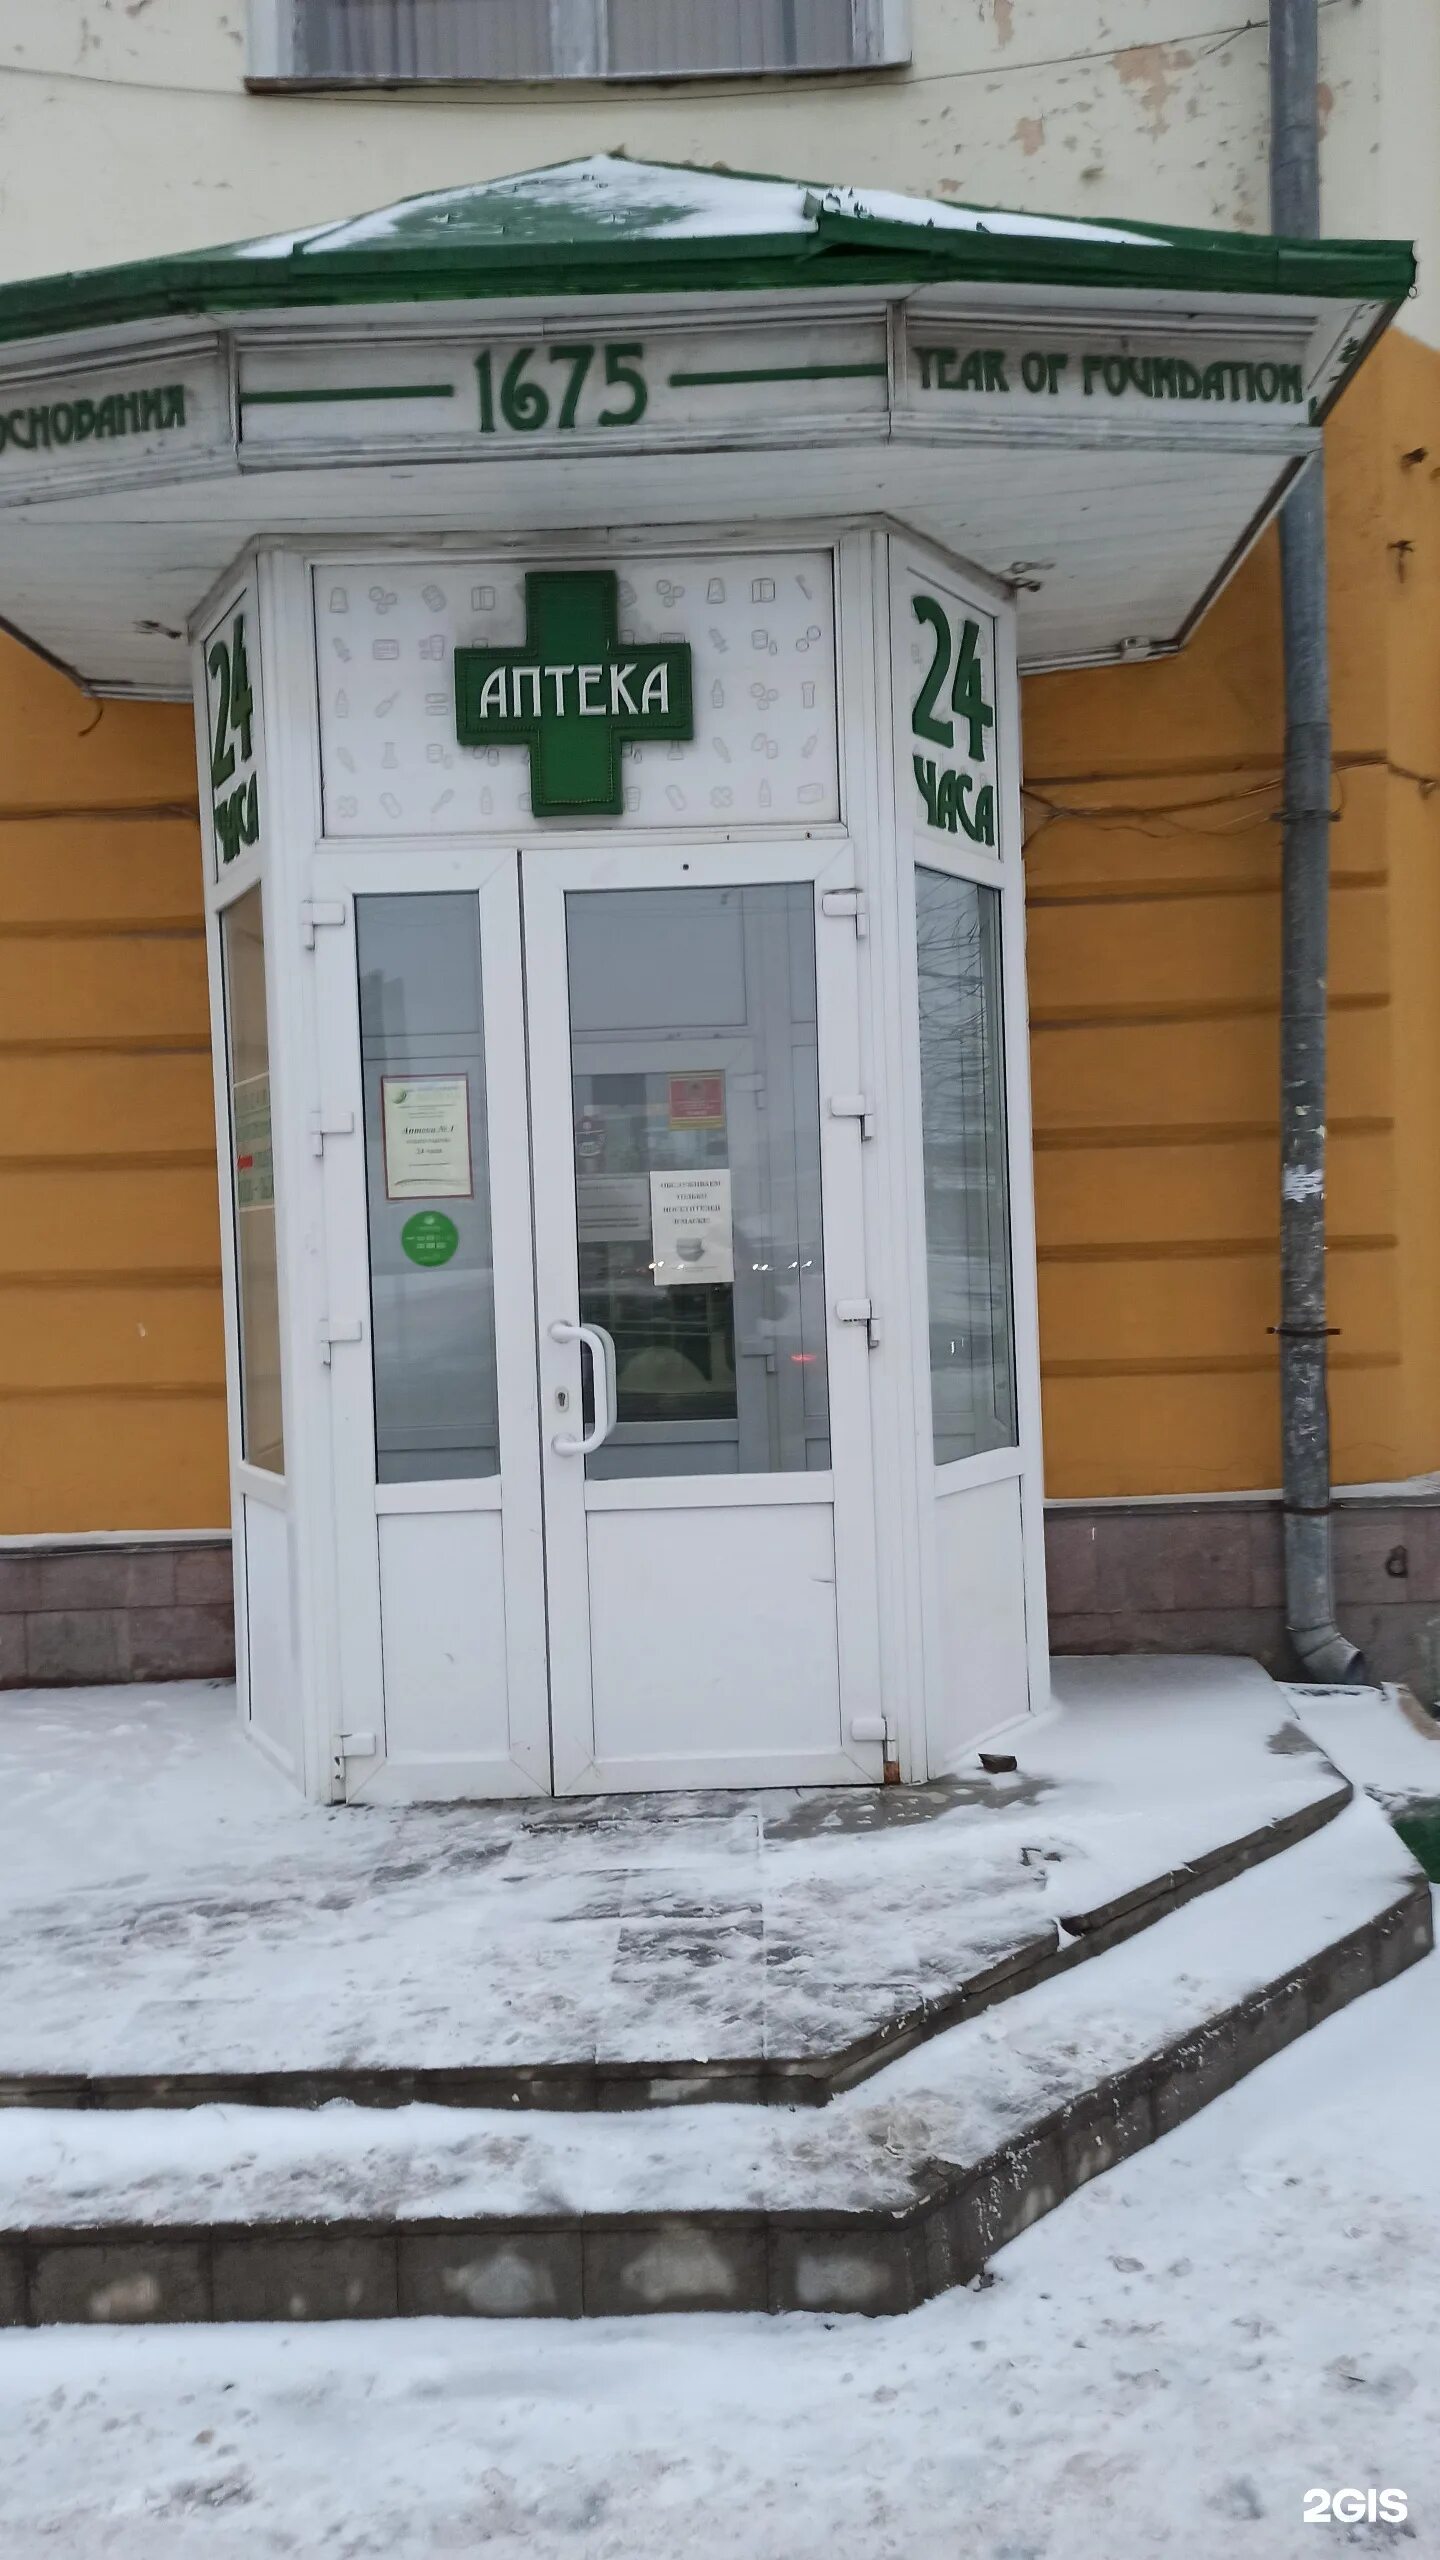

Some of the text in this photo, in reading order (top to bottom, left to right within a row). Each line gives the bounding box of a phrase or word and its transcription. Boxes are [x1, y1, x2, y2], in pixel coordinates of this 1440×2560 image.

[475, 342, 648, 432] 1675
[912, 346, 1303, 404] YEAR OF FOUNDATION
[208, 614, 253, 788] 24
[480, 663, 668, 718] АПТЕКА
[912, 595, 993, 762] 24
[913, 753, 995, 846] ЧАСА
